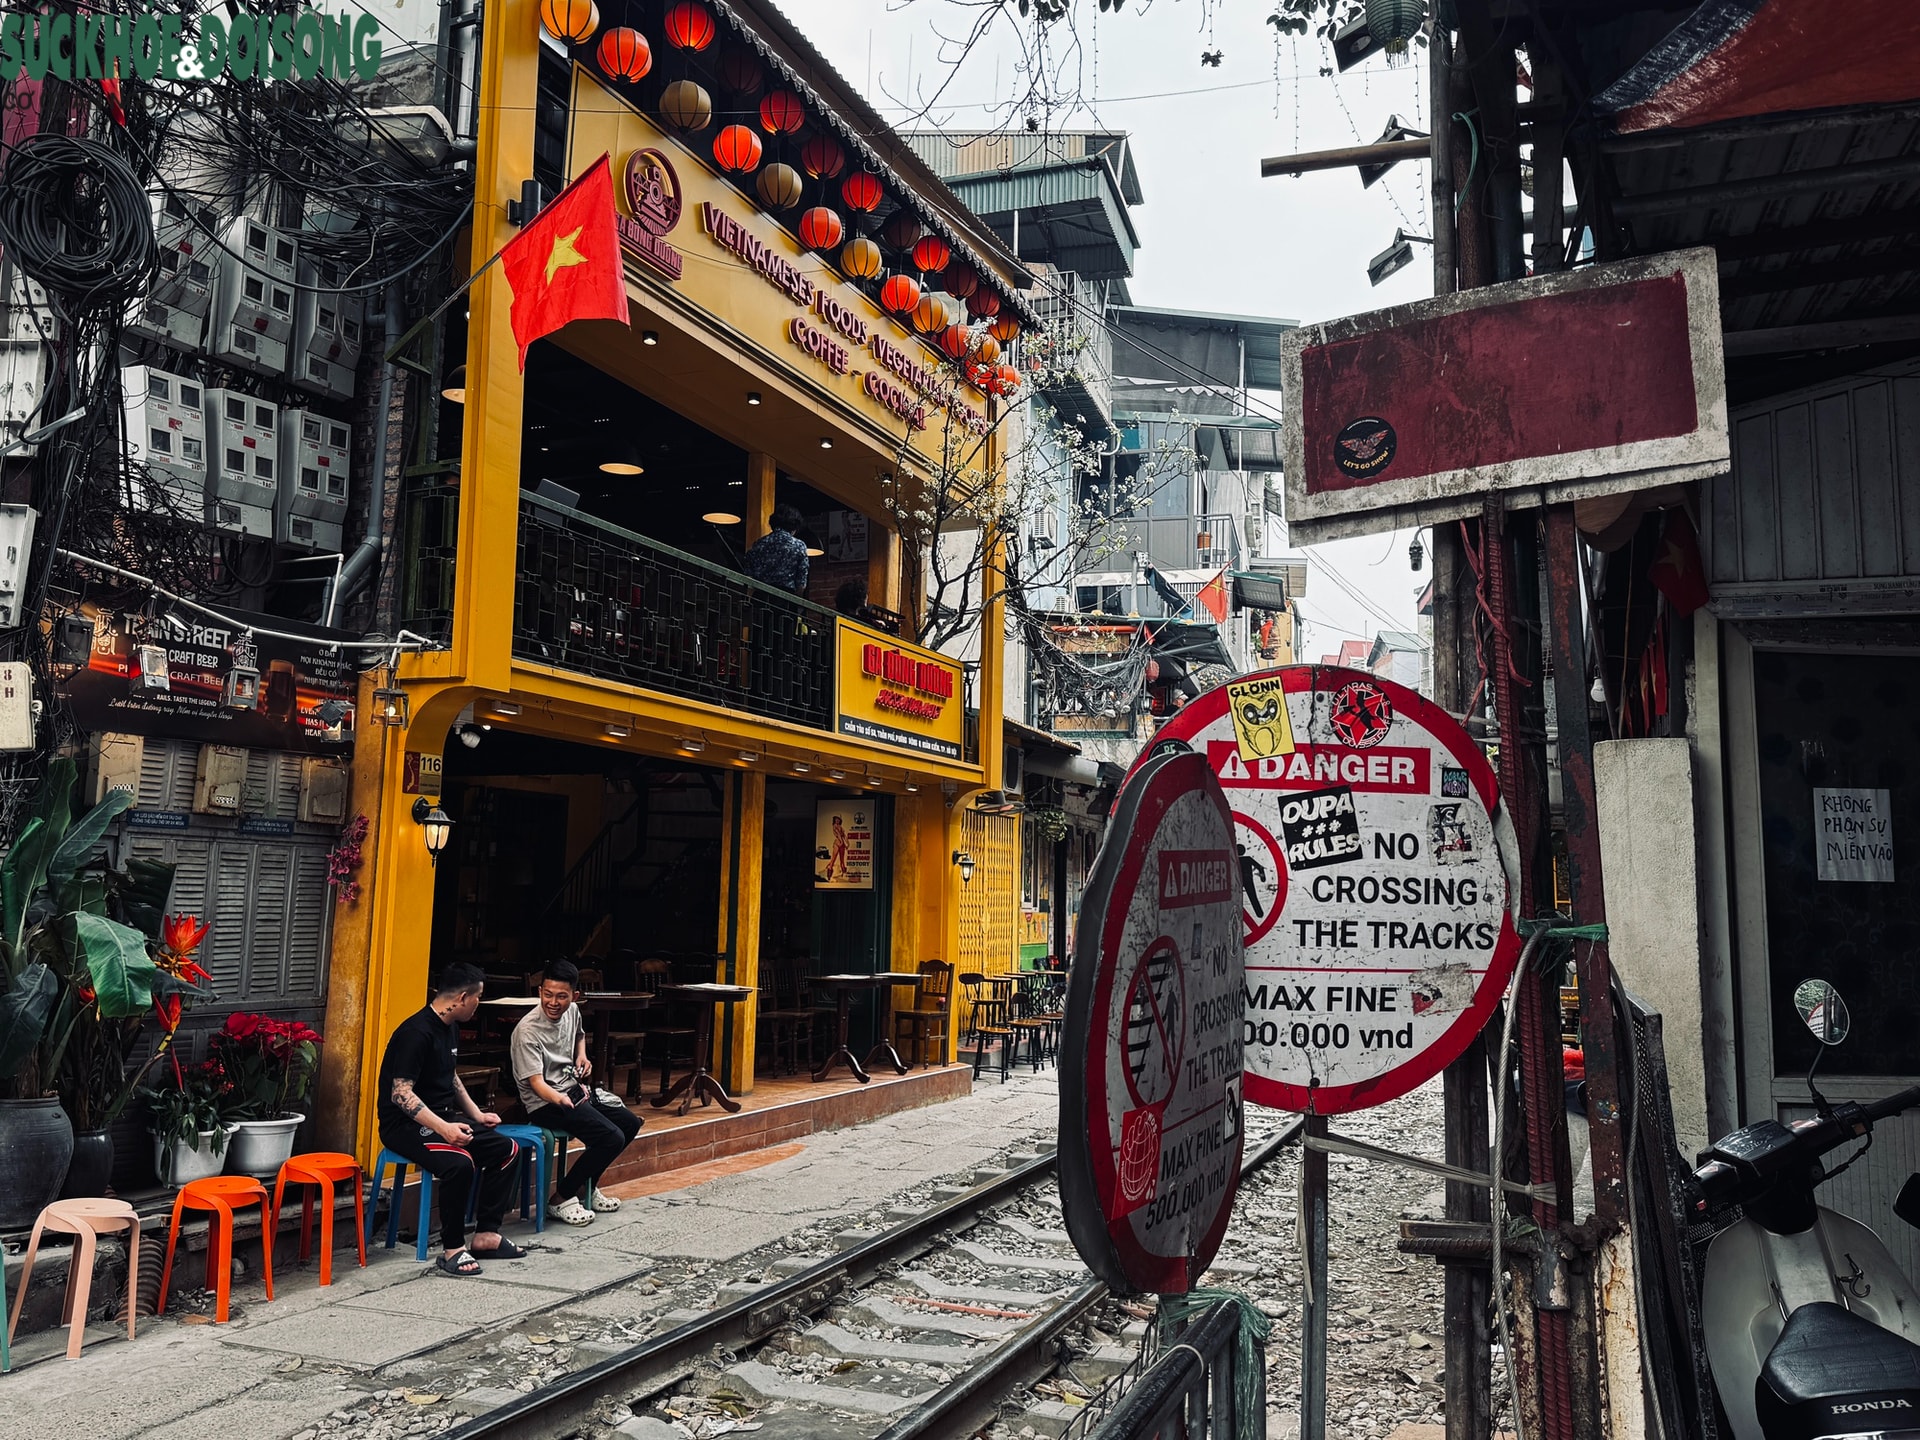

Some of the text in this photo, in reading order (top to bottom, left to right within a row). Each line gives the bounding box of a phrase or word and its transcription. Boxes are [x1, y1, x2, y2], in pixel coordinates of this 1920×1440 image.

[702, 201, 815, 306] VIETNAMESES
[815, 290, 868, 345] FOODS
[789, 317, 849, 375] COFFEE
[168, 649, 218, 669] CRAFT BEER
[862, 644, 882, 675] GA
[170, 671, 201, 683] CRAFT
[188, 697, 198, 705] THE
[421, 756, 441, 772] 116
[1258, 752, 1415, 785] DANGER
[1822, 794, 1872, 813] KHÔNG
[1289, 833, 1360, 864] RULES
[1374, 832, 1419, 860] NO
[1180, 860, 1228, 895] DANGER
[1312, 875, 1478, 906] CROSSING
[1293, 919, 1496, 950] THE TRACKS
[1213, 945, 1227, 977] NO
[1193, 987, 1245, 1035] CROSSING
[1244, 984, 1397, 1012] MAX FINE
[1244, 1020, 1414, 1050] 00.000 vnd
[1186, 1051, 1209, 1092] THE
[1161, 1147, 1193, 1182] MAX
[1196, 1119, 1221, 1165] FINE
[1145, 1180, 1206, 1231] 500.000
[1207, 1161, 1226, 1197] vnd
[1831, 1398, 1912, 1415] HONDA
